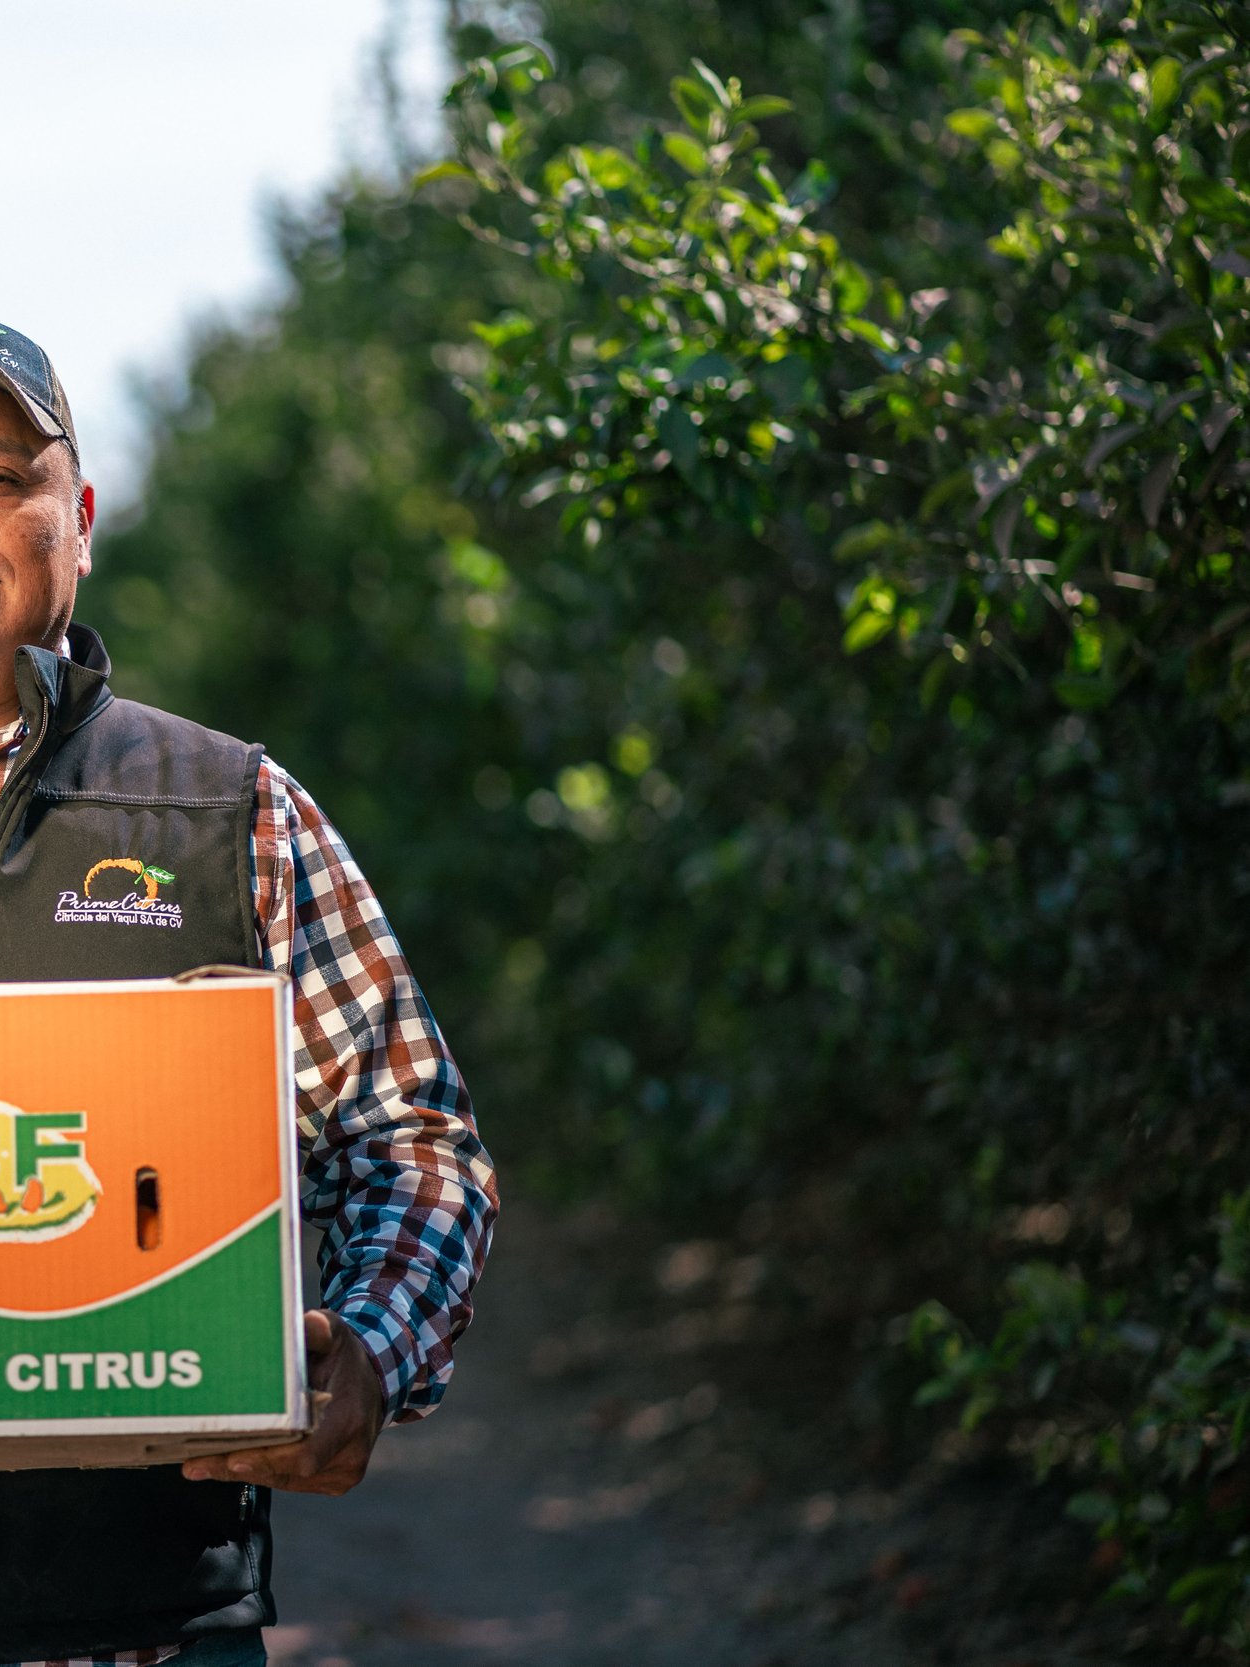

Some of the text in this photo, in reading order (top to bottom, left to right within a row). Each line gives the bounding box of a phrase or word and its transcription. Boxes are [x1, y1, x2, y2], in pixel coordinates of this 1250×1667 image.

[95, 911, 110, 922] del
[111, 912, 138, 925] Yaqui
[140, 914, 154, 925] SA
[155, 915, 168, 927] de
[169, 917, 183, 929] CV
[5, 1350, 203, 1391] CITRUS
